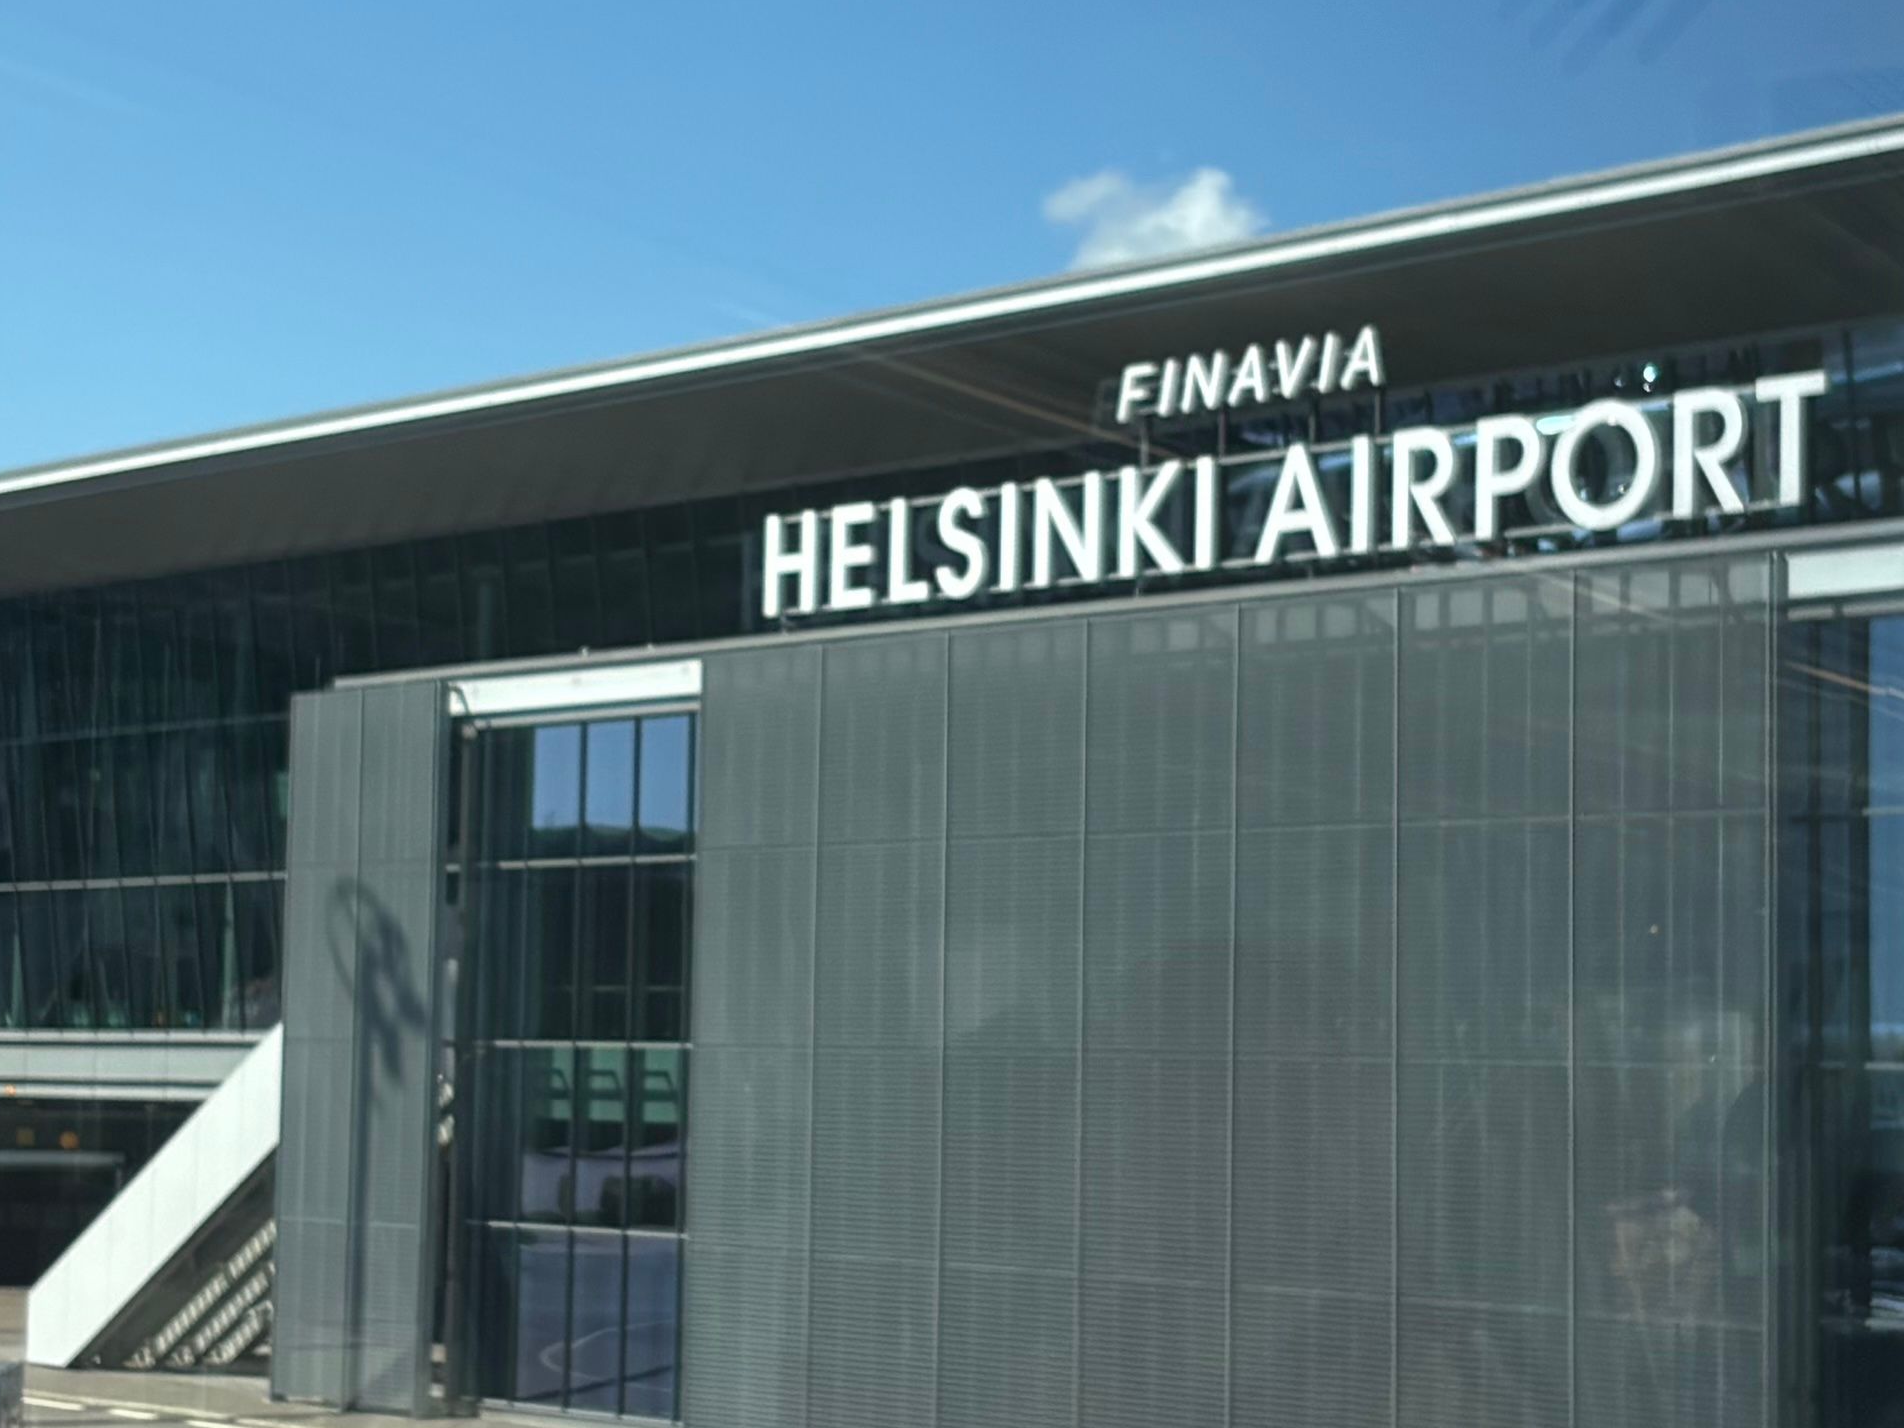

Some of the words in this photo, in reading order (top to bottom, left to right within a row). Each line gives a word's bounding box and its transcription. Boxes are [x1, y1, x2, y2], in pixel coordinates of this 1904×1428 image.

[1116, 324, 1386, 424] FINAVIA
[762, 456, 1216, 619] HELSINKI
[1255, 369, 1829, 564] AIRPORT
